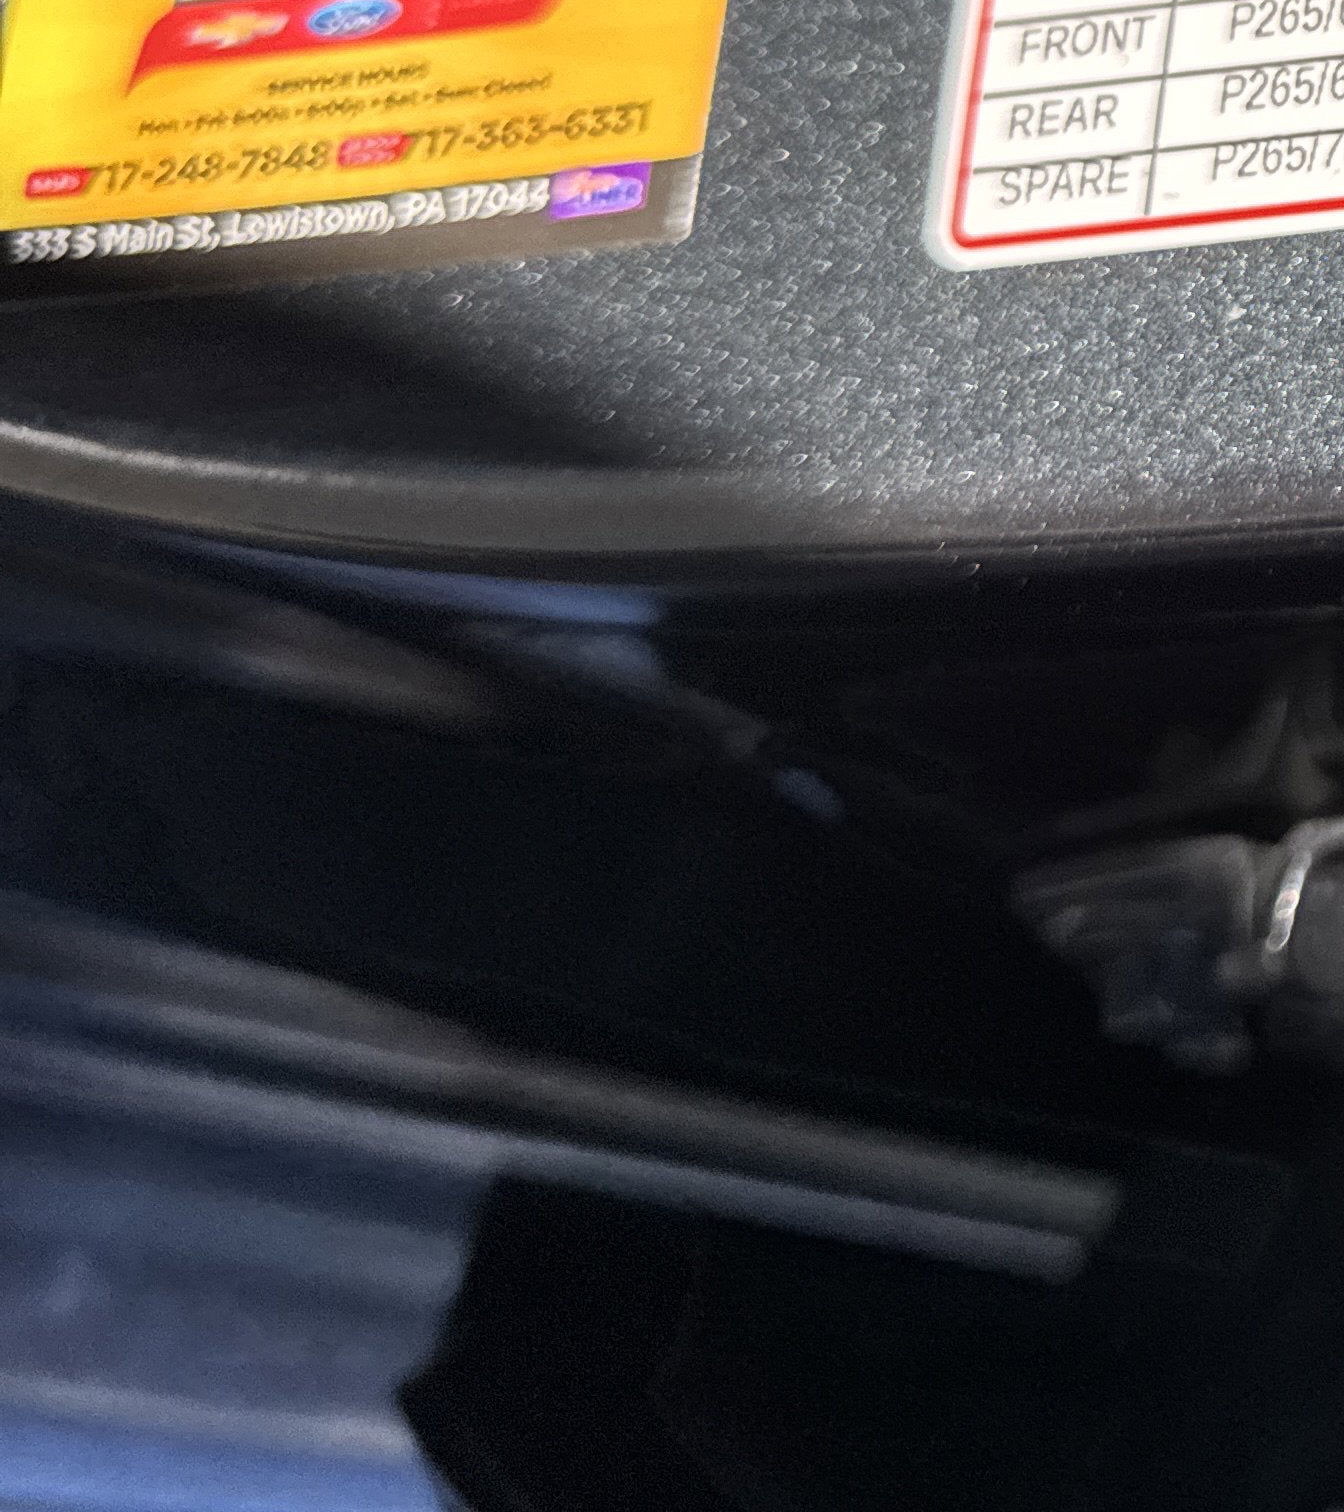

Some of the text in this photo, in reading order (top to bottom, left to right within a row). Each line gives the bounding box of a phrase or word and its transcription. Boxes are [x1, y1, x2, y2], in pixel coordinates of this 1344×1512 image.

[1018, 14, 1155, 65] FRONT
[1008, 93, 1118, 141] REAR
[1000, 157, 1133, 207] SPARE
[98, 219, 174, 257] Main
[391, 189, 446, 228] PA
